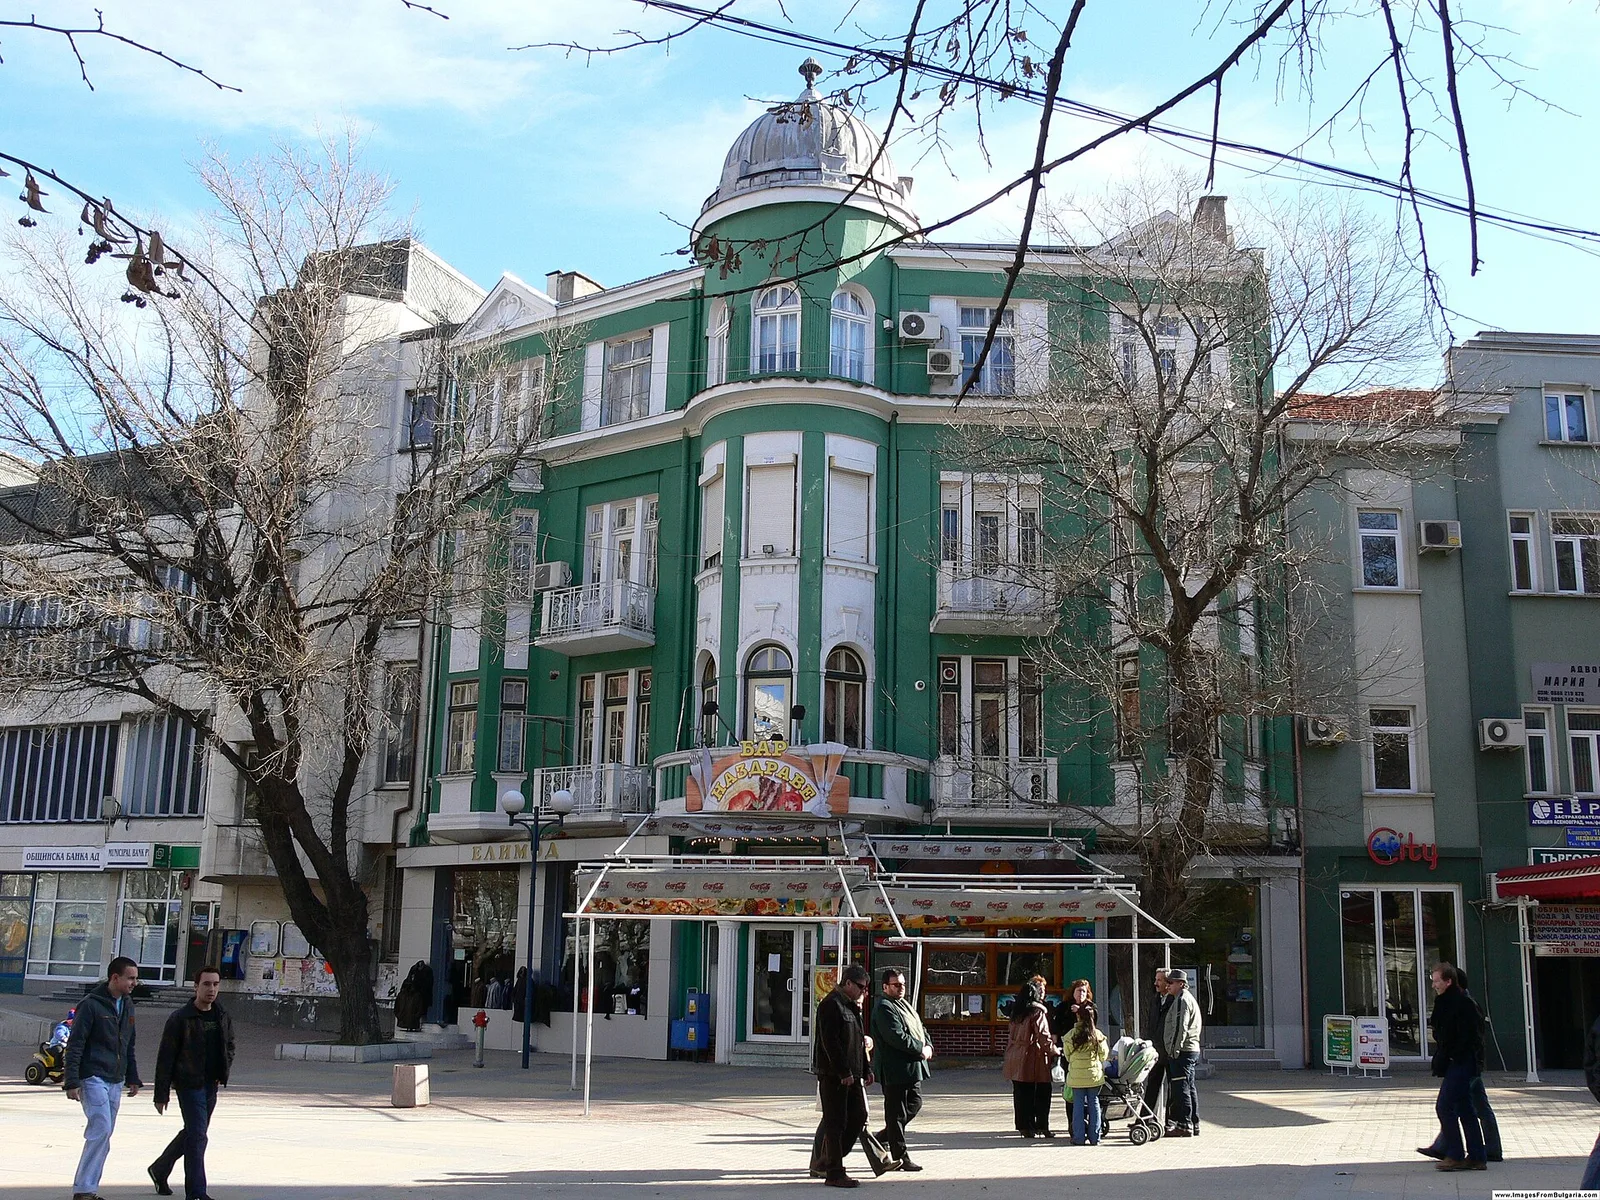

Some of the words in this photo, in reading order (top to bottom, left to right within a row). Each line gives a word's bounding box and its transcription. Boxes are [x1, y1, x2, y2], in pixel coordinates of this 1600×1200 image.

[1570, 665, 1600, 673] АДВО
[1544, 676, 1585, 687] МАРИЯ
[740, 741, 788, 757] БАР
[711, 760, 816, 801] НАЗДРАВЕ
[108, 849, 131, 857] MUNICIPAL
[1368, 827, 1438, 870] City
[26, 853, 65, 861] ОБЩИНСКА
[66, 853, 88, 861] БАНКА
[90, 853, 100, 862] АД
